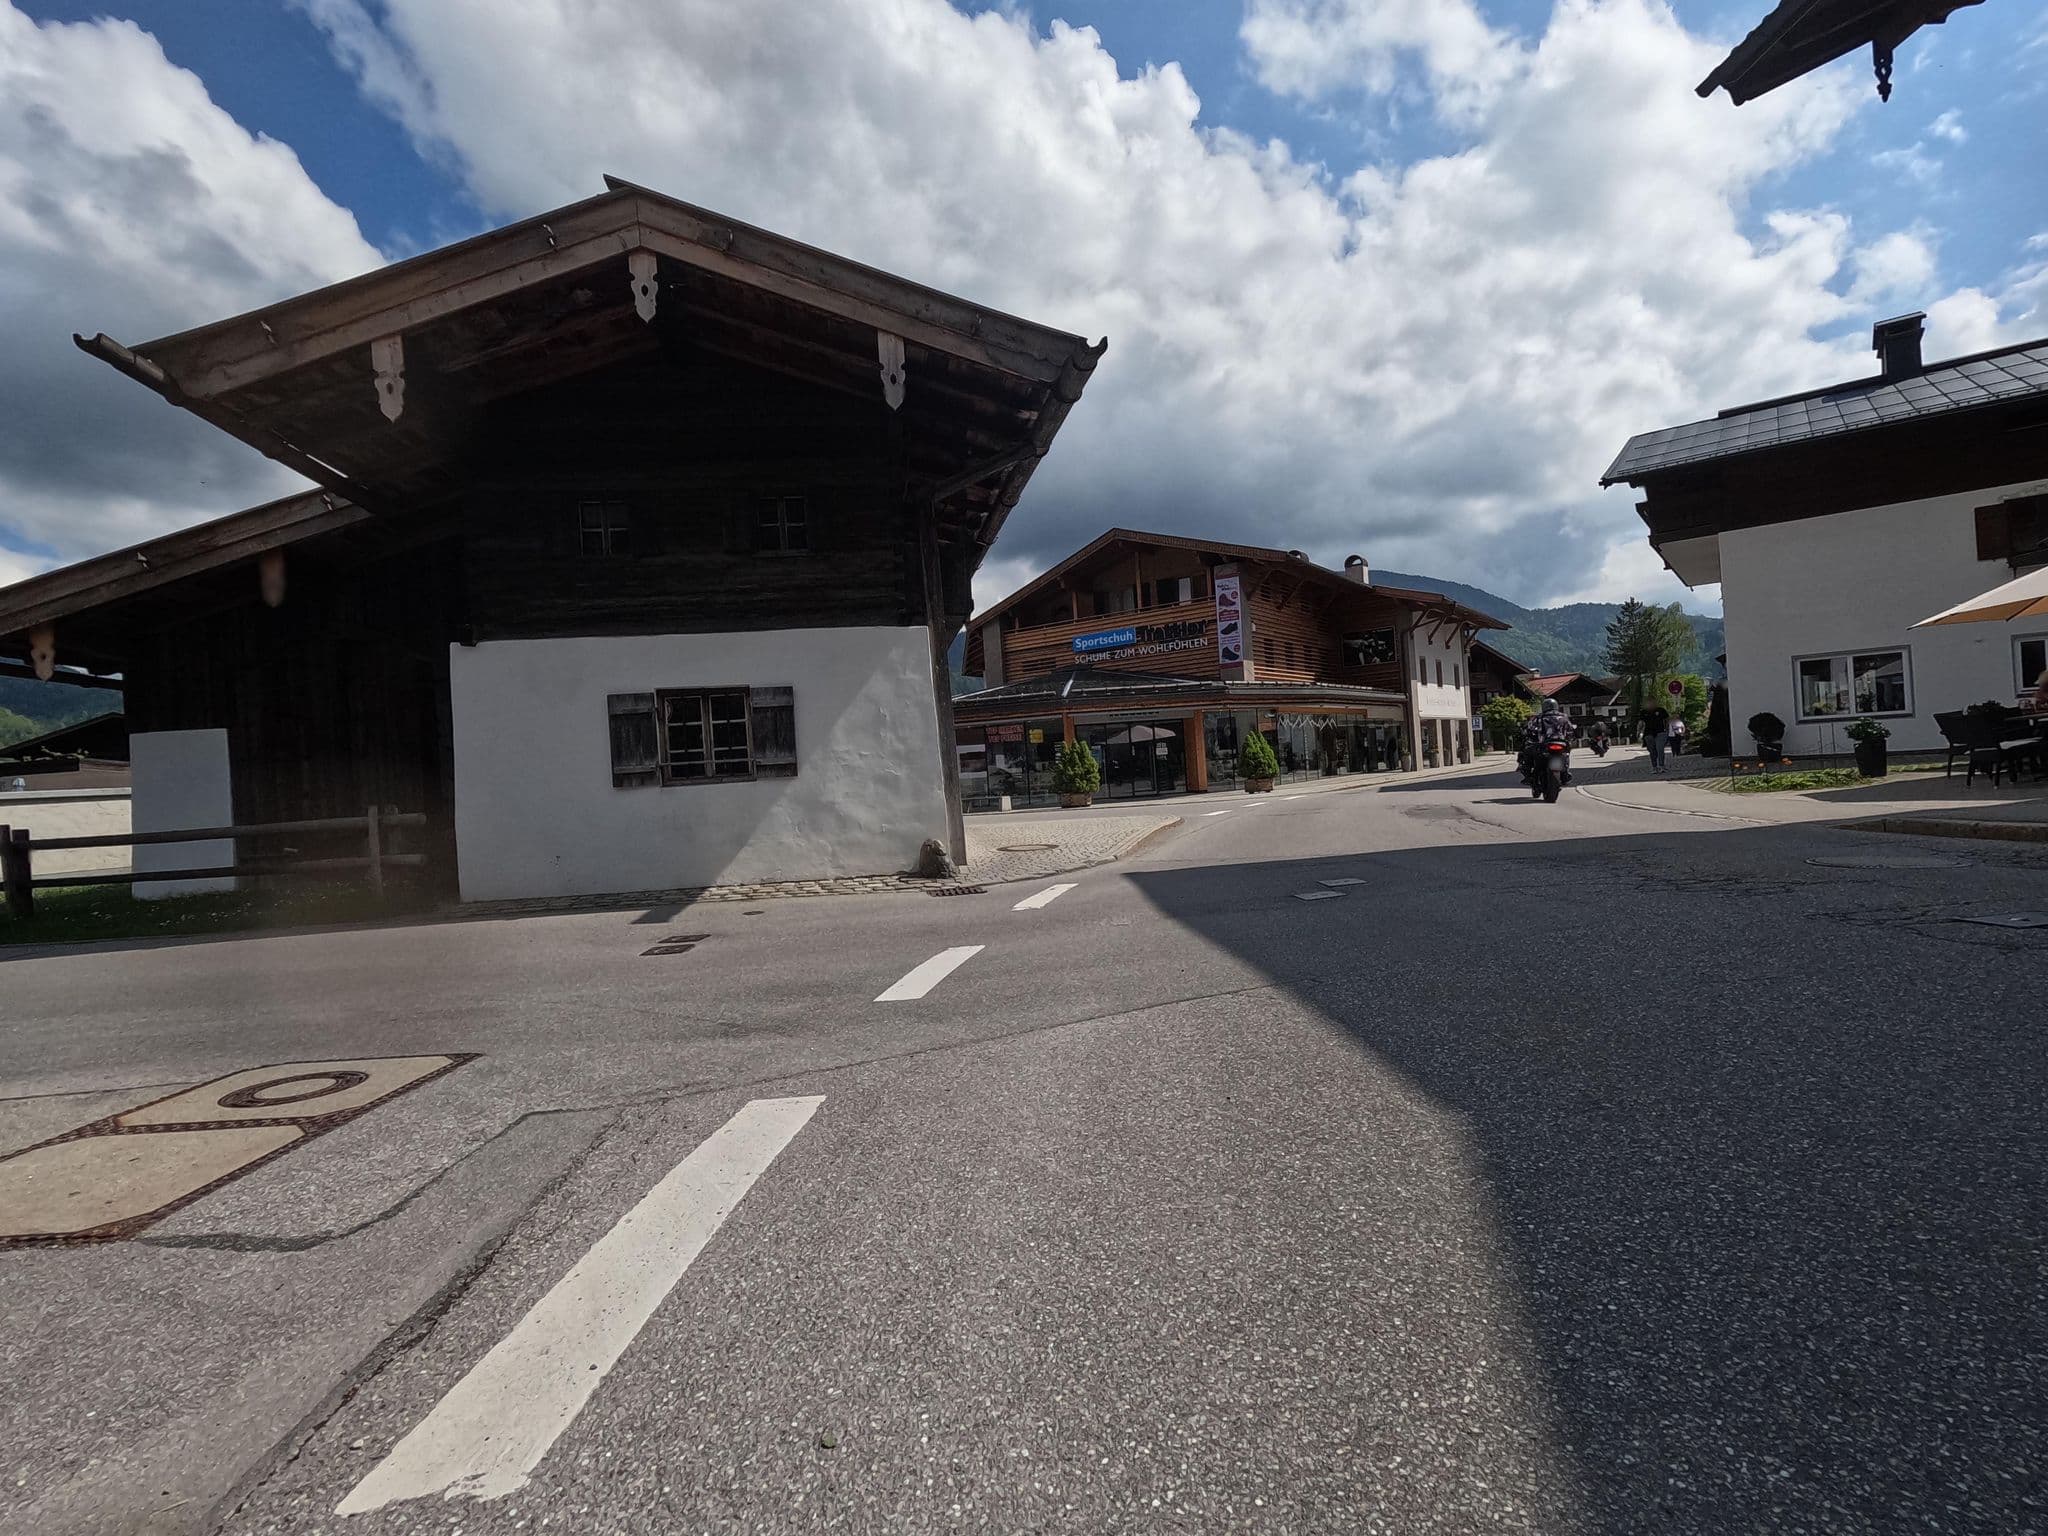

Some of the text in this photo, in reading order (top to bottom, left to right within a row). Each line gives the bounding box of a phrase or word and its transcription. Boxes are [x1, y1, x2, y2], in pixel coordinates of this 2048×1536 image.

[1074, 651, 1112, 664] SCHUHE
[1114, 647, 1136, 660] ZUM
[1138, 636, 1208, 656] WOHLFÜHLEN
[1075, 631, 1133, 649] Sportschuh
